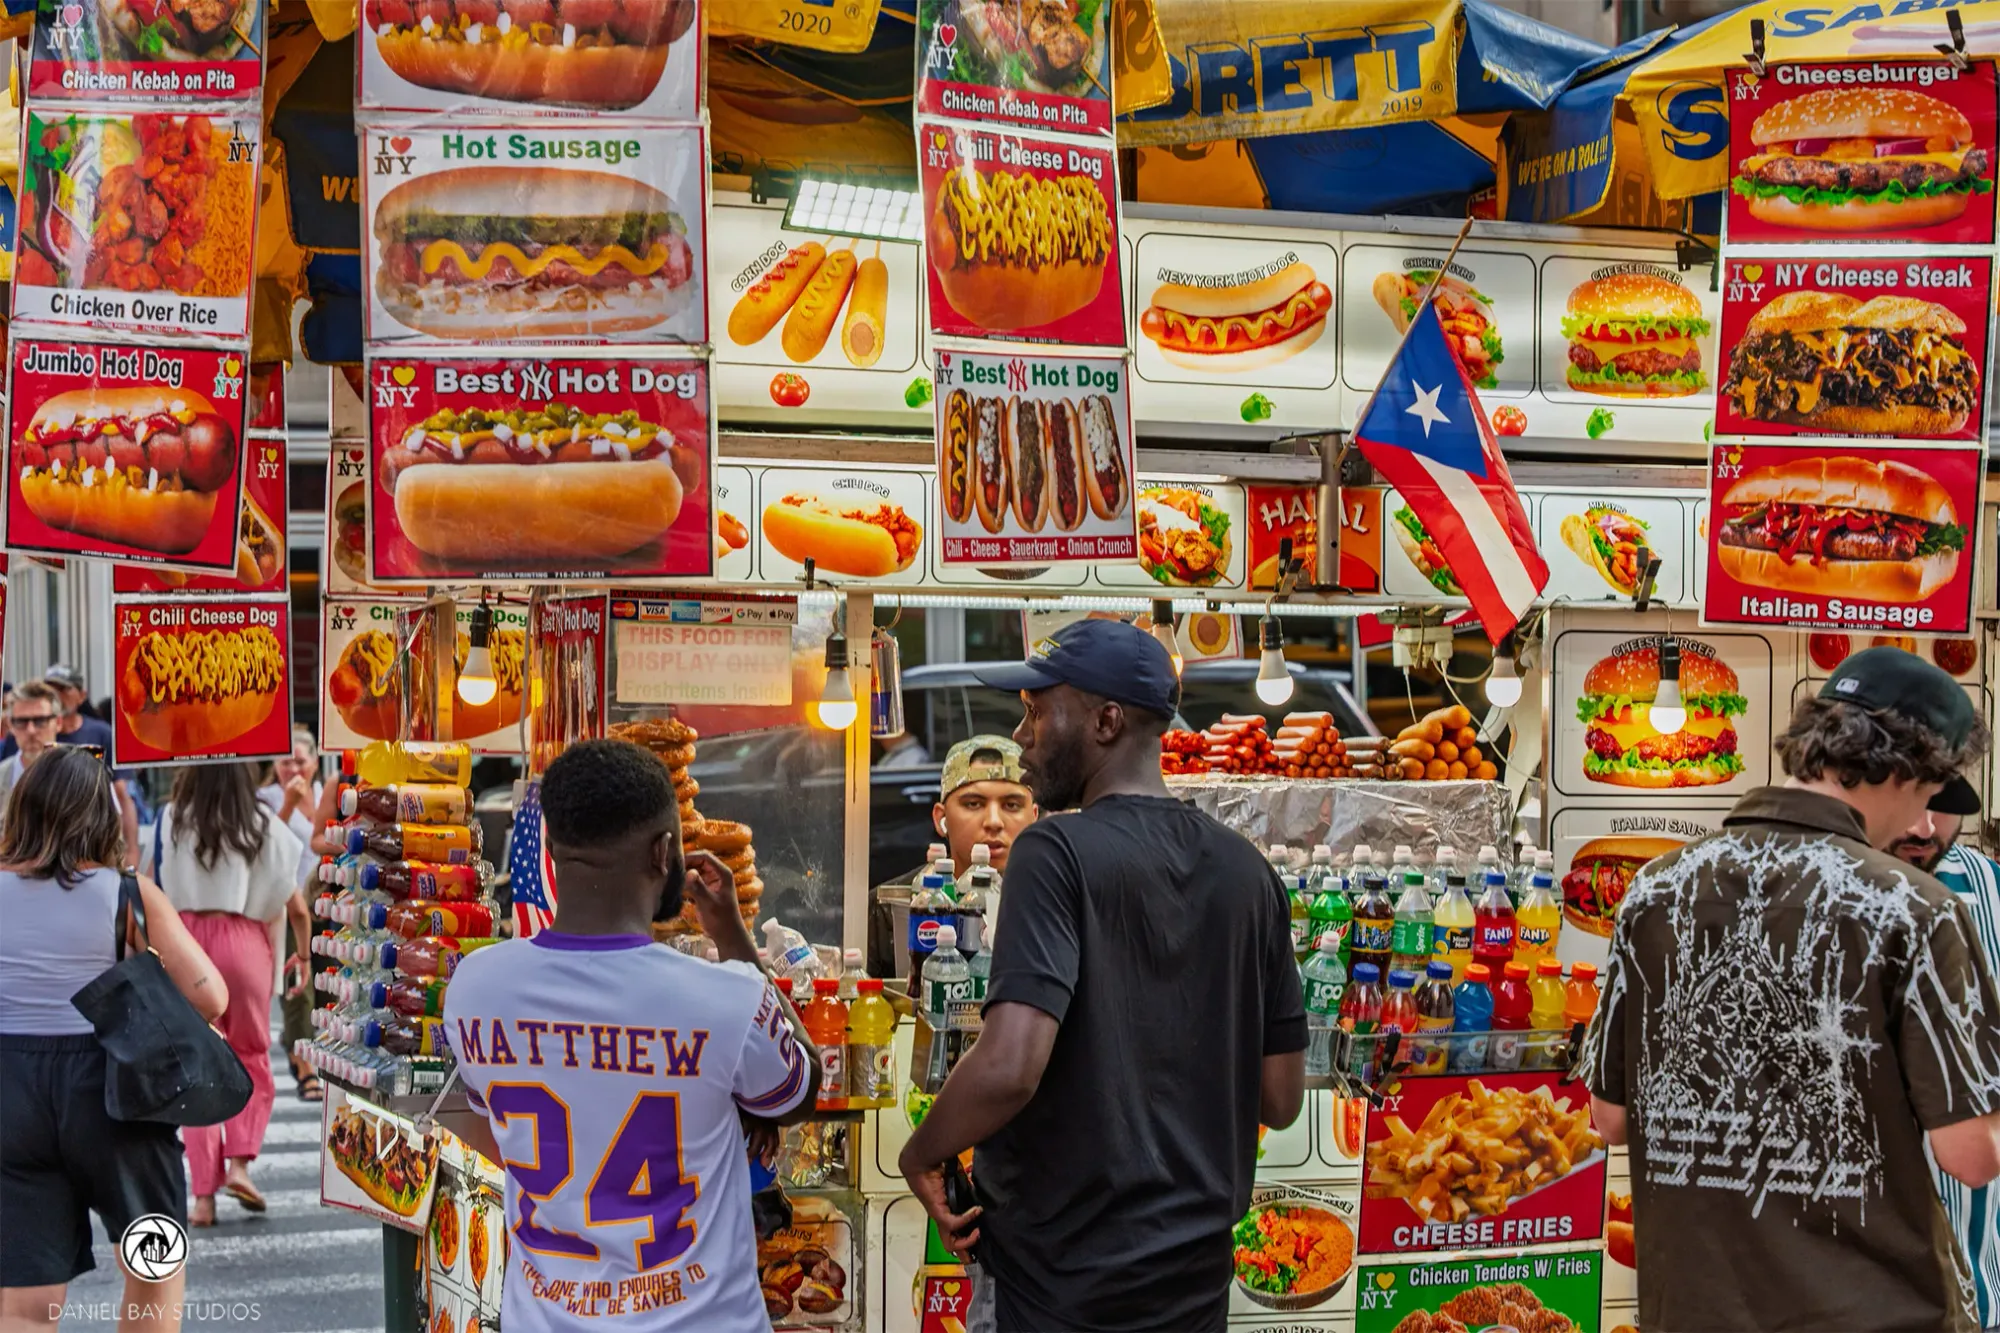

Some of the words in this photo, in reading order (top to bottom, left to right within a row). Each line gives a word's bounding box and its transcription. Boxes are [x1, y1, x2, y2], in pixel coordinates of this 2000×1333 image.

[778, 9, 832, 35] 2020
[47, 28, 84, 50] NY
[927, 47, 958, 70] NY
[62, 69, 127, 90] Chicken
[131, 71, 180, 91] Kebab
[184, 77, 202, 91] on
[206, 72, 235, 90] Pita
[1776, 63, 1960, 87] Cheeseburger
[1734, 85, 1763, 100] NY
[942, 89, 995, 113] Chicken
[999, 97, 1040, 119] Kebab
[1042, 105, 1059, 121] on
[1061, 103, 1088, 125] Pita
[1380, 95, 1423, 116] 2019
[228, 142, 257, 162] NY
[378, 136, 389, 155] I
[442, 135, 497, 159] Hot
[508, 137, 641, 164] Sausage
[374, 157, 416, 175] NY
[928, 150, 949, 168] NY
[954, 136, 994, 160] Chili
[999, 139, 1063, 170] Cheese
[1068, 150, 1103, 180] Dog
[1553, 151, 1566, 177] ON
[1567, 148, 1575, 173] A
[731, 260, 763, 293] CORN
[759, 240, 787, 268] DOG
[1158, 267, 1194, 285] NEW
[1194, 272, 1238, 288] YORK
[1237, 267, 1267, 285] HOT
[1267, 252, 1300, 273] DOG
[1590, 262, 1682, 285] CHEESEBURGER
[1732, 265, 1743, 284] I
[1775, 264, 1809, 287] NY
[1815, 264, 1899, 287] Cheese
[1905, 264, 1973, 288] Steak
[1727, 284, 1765, 302] NY
[50, 294, 125, 320] Chicken
[133, 301, 174, 322] Over
[180, 303, 218, 325] Rice
[23, 345, 94, 374] Jumbo
[101, 350, 138, 379] Hot
[144, 352, 183, 387] Dog
[380, 366, 391, 386] I
[936, 368, 953, 385] NY
[961, 359, 1006, 385] Best
[1031, 363, 1069, 387] Hot
[1076, 365, 1119, 393] Dog
[213, 377, 242, 398] NY
[435, 367, 515, 394] Best
[558, 367, 620, 394] Hot
[631, 367, 698, 399] Dog
[375, 387, 420, 408] NY
[257, 463, 279, 479] NY
[337, 463, 365, 477] NY
[1717, 465, 1743, 480] NY
[832, 480, 864, 490] CHILI
[864, 482, 890, 498] DOG
[1259, 494, 1370, 533] HAL
[946, 541, 963, 557] Chili
[970, 540, 1001, 557] Cheese
[1009, 540, 1059, 557] Sauerkraut
[1067, 539, 1095, 556] Onion
[1097, 538, 1132, 555] Crunch
[515, 571, 548, 579] PRINTING
[149, 609, 185, 625] Chili
[190, 608, 245, 624] Cheese
[249, 608, 278, 627] Dog
[494, 608, 528, 627] Dog
[645, 606, 666, 615] VISA
[747, 609, 763, 620] Pay
[778, 610, 795, 621] Pay
[1740, 596, 1819, 619] Italian
[1826, 600, 1933, 627] Sausage
[122, 622, 143, 637] NY
[331, 618, 358, 630] NY
[564, 610, 580, 630] Hot
[581, 609, 600, 634] Dog
[627, 626, 674, 645] THIS
[681, 627, 736, 646] FOOD
[742, 629, 784, 647] FOR
[621, 651, 720, 673] DISPLAY
[726, 654, 788, 674] ONLY
[1611, 817, 1666, 832] ITALIAN
[1415, 924, 1426, 953] Sprite
[458, 1017, 709, 1077] MATTHEW
[486, 1080, 701, 1273] 24
[1393, 1221, 1494, 1248] CHEESE
[1502, 1215, 1574, 1242] FRIES
[550, 1279, 579, 1298] ONE
[583, 1281, 612, 1299] WHO
[619, 1270, 681, 1299] ENDURES
[686, 1263, 706, 1285] TO
[1365, 1272, 1375, 1291] I
[1409, 1267, 1470, 1287] Chicken
[1474, 1262, 1530, 1283] Tenders
[1534, 1258, 1553, 1277] W/
[1556, 1257, 1591, 1276] Fries
[566, 1298, 601, 1317] WILL
[607, 1298, 626, 1316] BE
[633, 1287, 688, 1313] SAVED.
[927, 1296, 962, 1313] NY
[1360, 1290, 1400, 1310] NY
